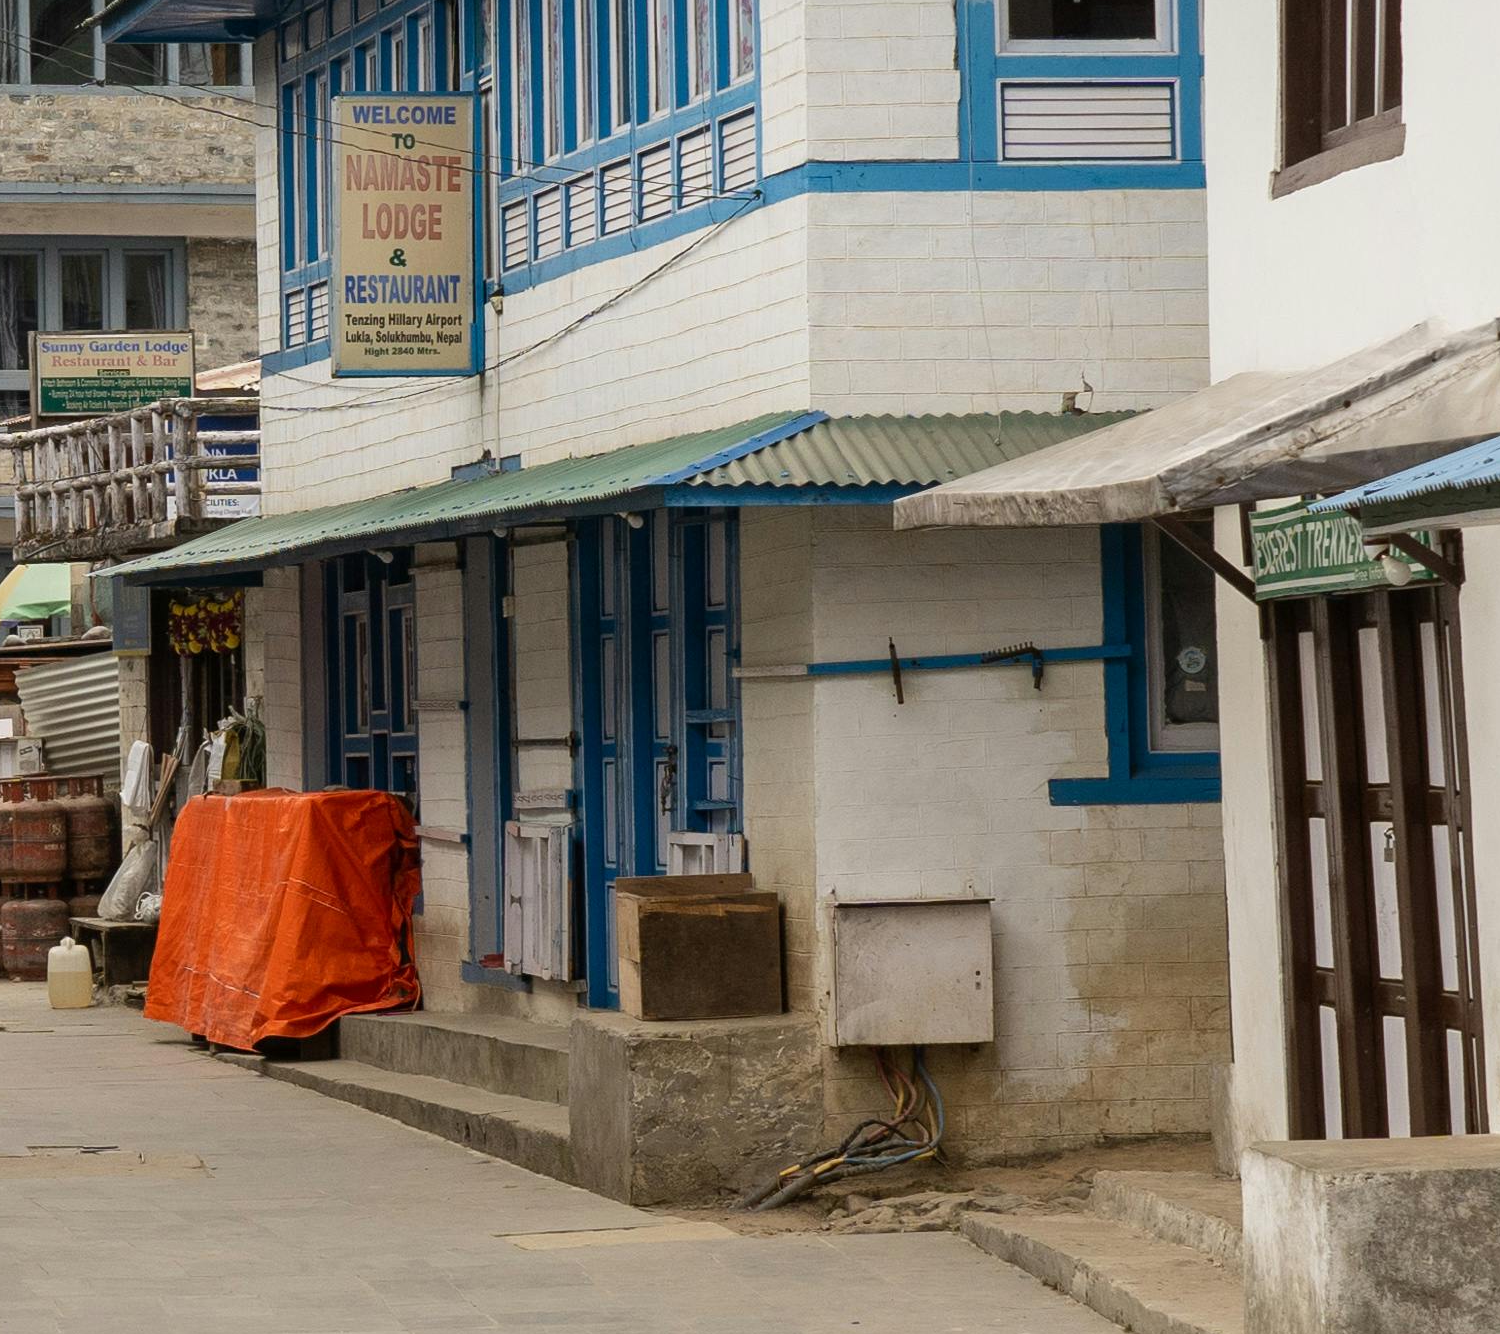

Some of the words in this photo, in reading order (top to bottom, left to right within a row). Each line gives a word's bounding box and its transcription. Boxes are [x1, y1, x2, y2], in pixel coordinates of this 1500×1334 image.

[353, 105, 456, 124] WELCOME
[391, 133, 415, 149] TO
[346, 155, 461, 192] NAMASTE
[362, 203, 442, 240] LODGE
[389, 249, 407, 267] &
[345, 275, 461, 304] RESTAURANT
[345, 314, 385, 328] Tenzing
[388, 314, 422, 328] Hillary
[425, 315, 462, 328] Airport
[346, 331, 373, 345] Lukla,
[376, 331, 434, 345] Solukhumbu,
[436, 331, 462, 346] Nepal
[42, 342, 84, 355] Sunny
[89, 341, 140, 352] Garden
[145, 341, 188, 355] Lodge
[364, 347, 389, 357] Hight
[52, 355, 131, 367] Restaurant
[136, 355, 148, 366] &
[152, 355, 177, 366] Bar
[209, 469, 238, 480] KLA
[206, 499, 239, 507] CILITIES:
